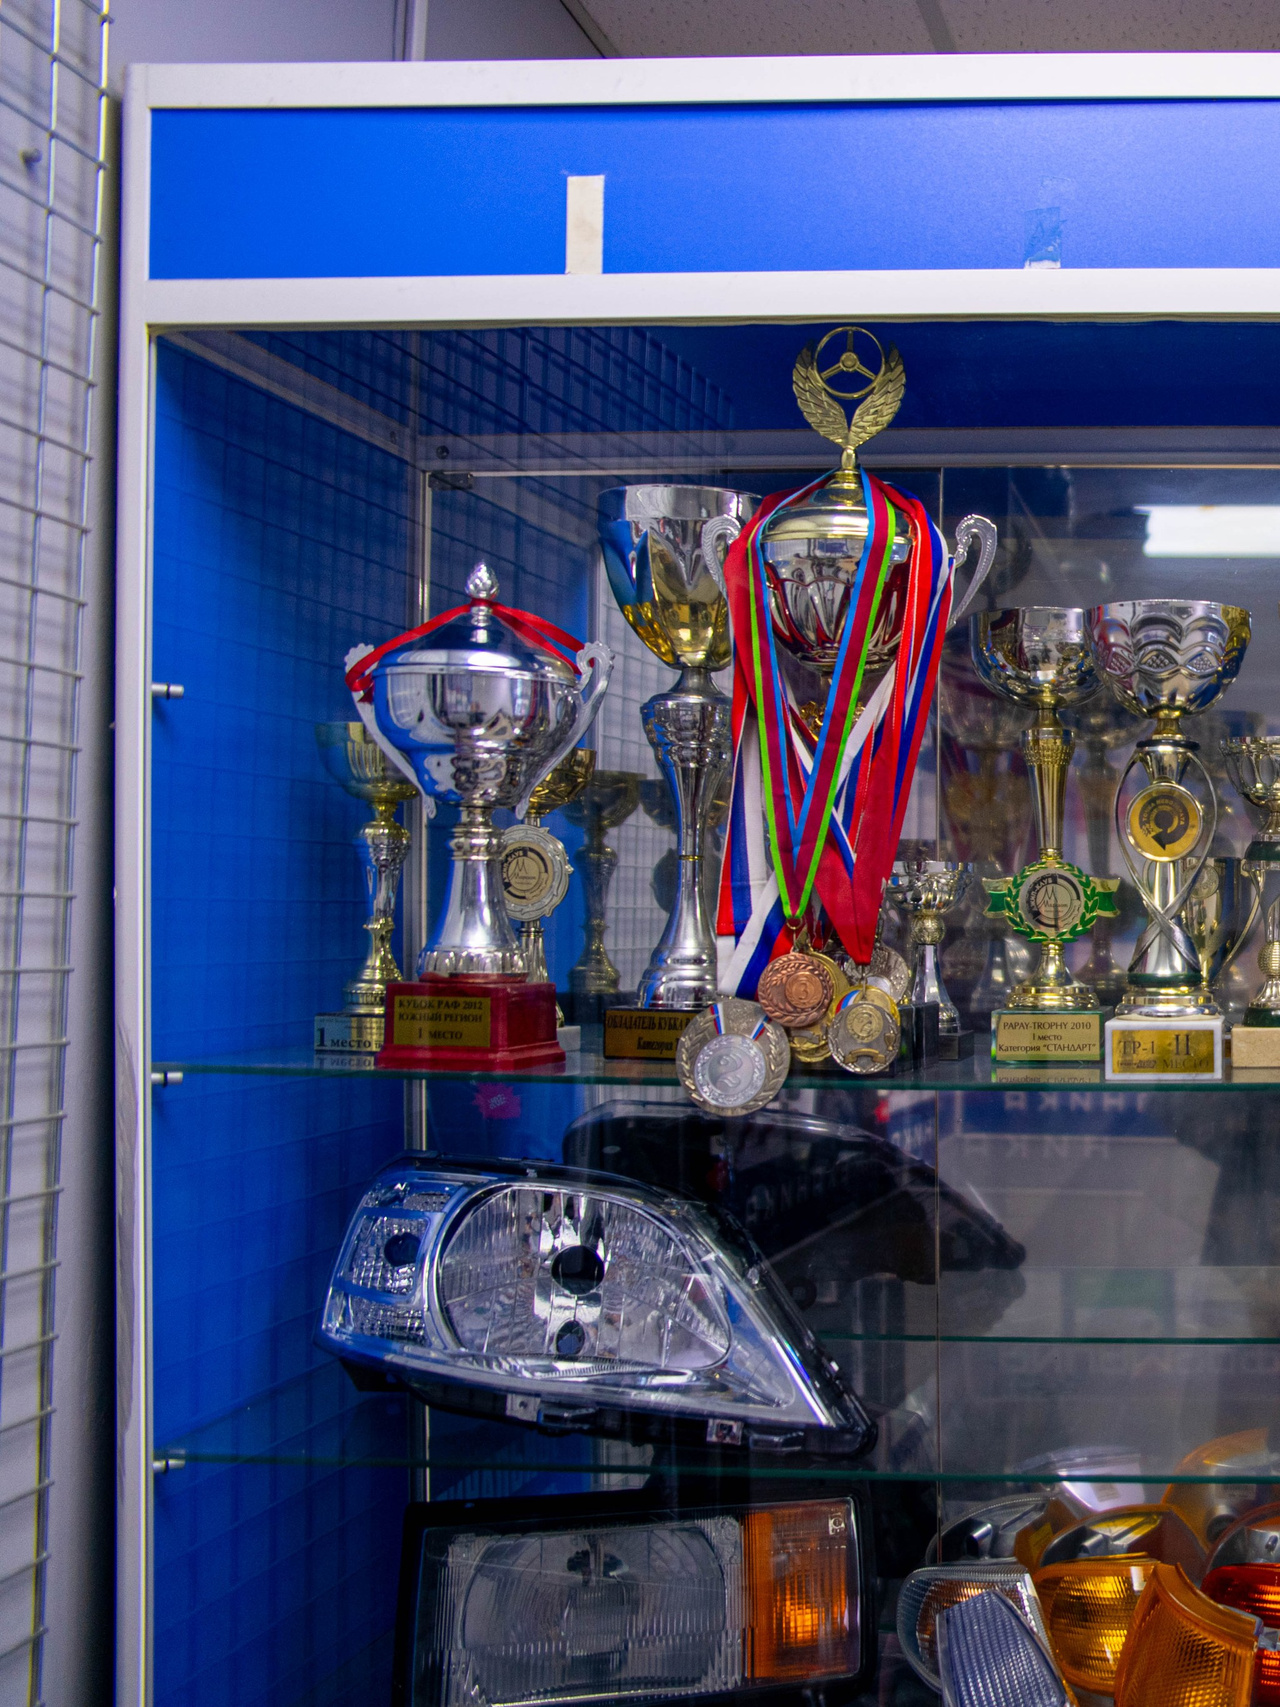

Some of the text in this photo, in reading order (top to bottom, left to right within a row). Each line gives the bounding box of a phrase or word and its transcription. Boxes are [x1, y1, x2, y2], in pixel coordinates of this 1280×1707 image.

[797, 982, 809, 1001] 3
[399, 999, 483, 1010] КУБОК РАФ 2012
[399, 1011, 483, 1022] ЮЖНЫЙ РЕГИОН
[1003, 1021, 1091, 1030] PAPAY-TROPHY 2010
[316, 1027, 328, 1047] 1
[330, 1038, 371, 1049] место
[429, 1030, 463, 1039] МЕСТО
[998, 1044, 1041, 1054] Категория
